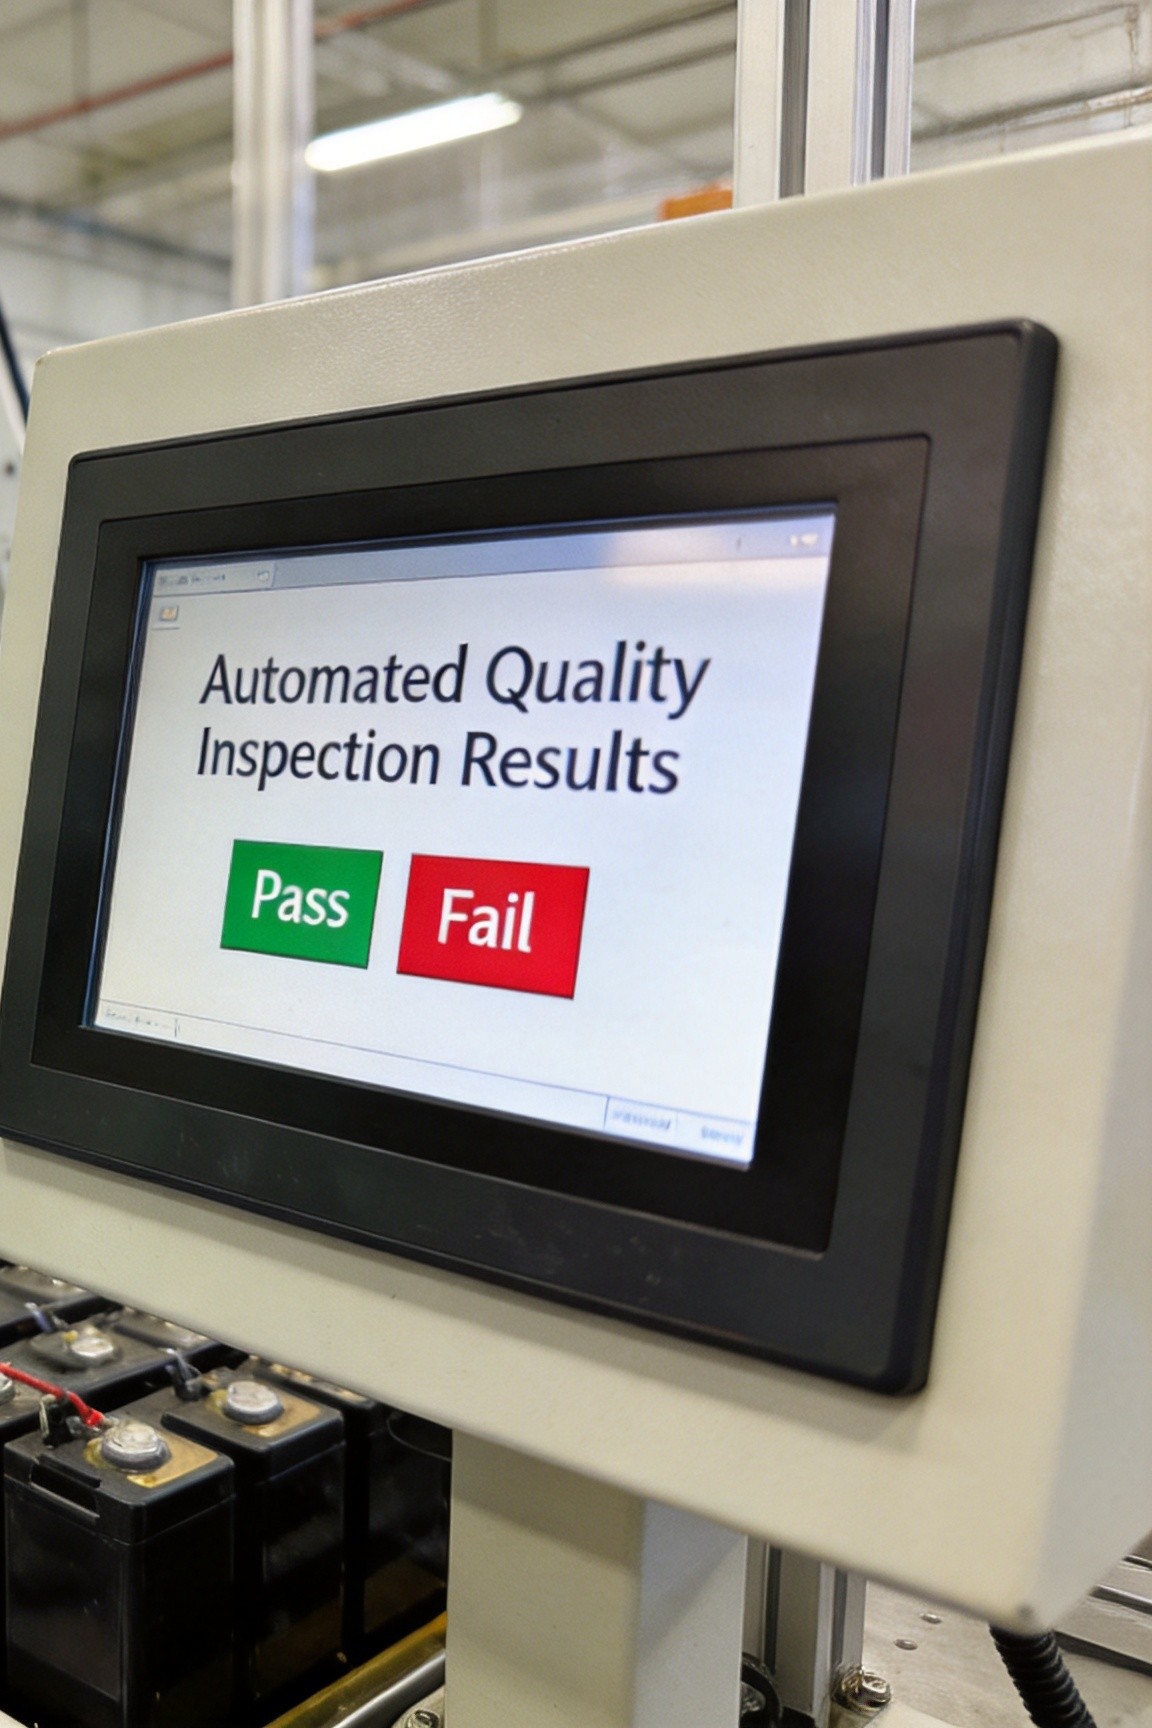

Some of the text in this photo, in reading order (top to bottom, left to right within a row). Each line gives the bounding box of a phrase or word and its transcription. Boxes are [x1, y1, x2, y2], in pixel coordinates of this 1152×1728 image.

[198, 640, 711, 721] Automated Quality
[197, 726, 680, 795] Inspection Results
[251, 869, 535, 953] Pass Fail
